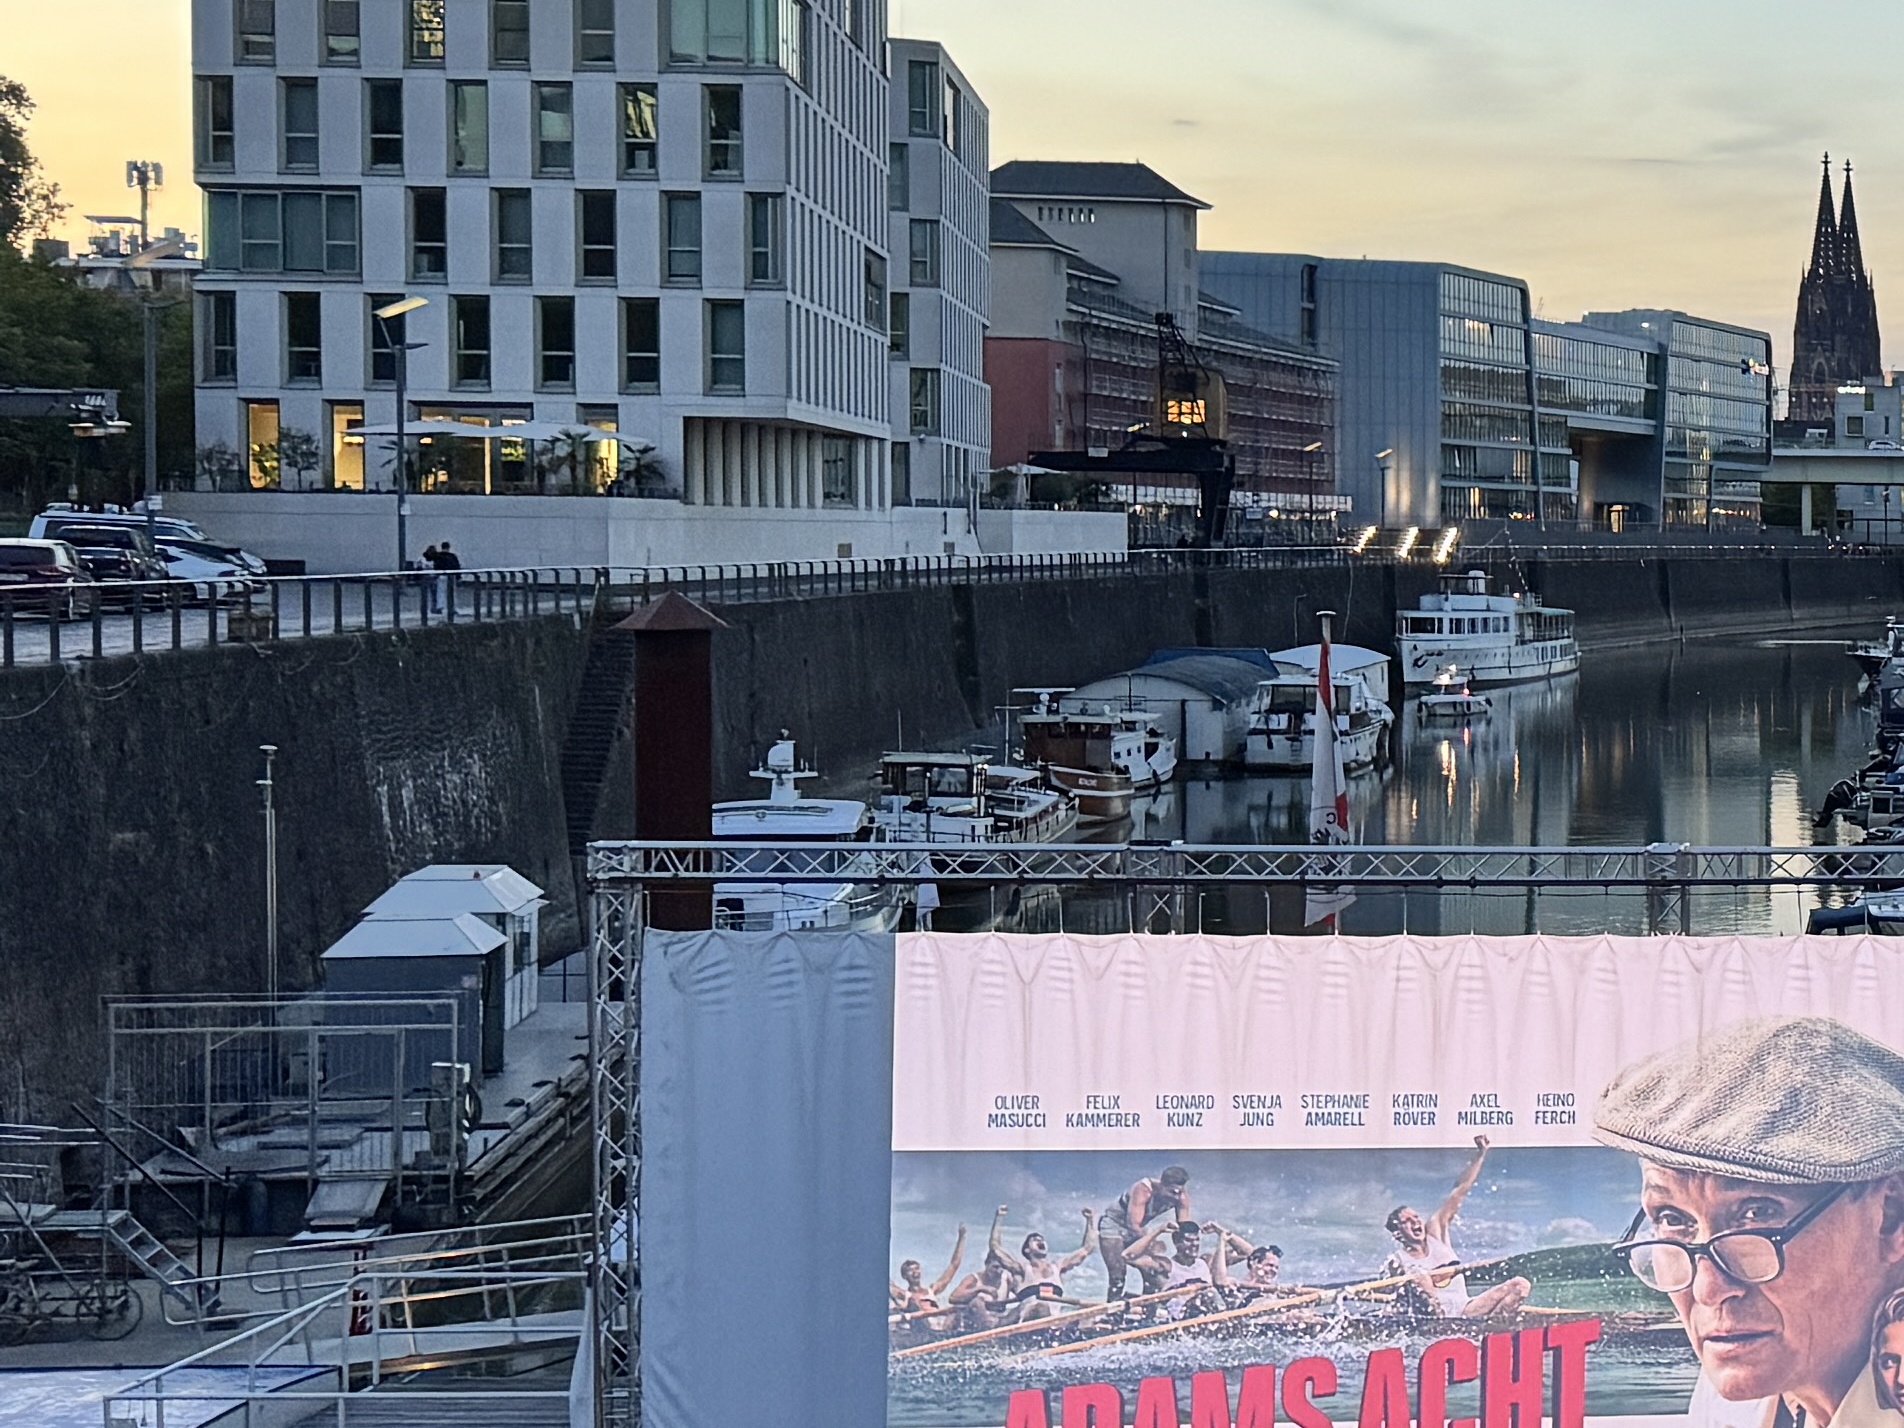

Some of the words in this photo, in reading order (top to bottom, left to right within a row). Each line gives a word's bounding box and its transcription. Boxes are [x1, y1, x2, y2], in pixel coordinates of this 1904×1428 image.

[994, 1094, 1040, 1111] OLIVER
[1086, 1094, 1121, 1110] FELIX
[1156, 1094, 1215, 1110] LEONARD
[1232, 1094, 1283, 1110] SVENJA
[1300, 1094, 1370, 1110] STEPHANIE
[1392, 1093, 1438, 1109] KATRIN
[1469, 1093, 1501, 1109] AXEL
[1537, 1092, 1575, 1108] HEINO
[988, 1112, 1047, 1129] MASUCCI
[1066, 1112, 1141, 1129] KAMMERER
[1167, 1112, 1204, 1128] KUNZ
[1239, 1112, 1275, 1128] JUNG
[1305, 1111, 1366, 1127] AMARELL
[1457, 1110, 1514, 1127] MILBERG
[1535, 1110, 1577, 1126] FERCH
